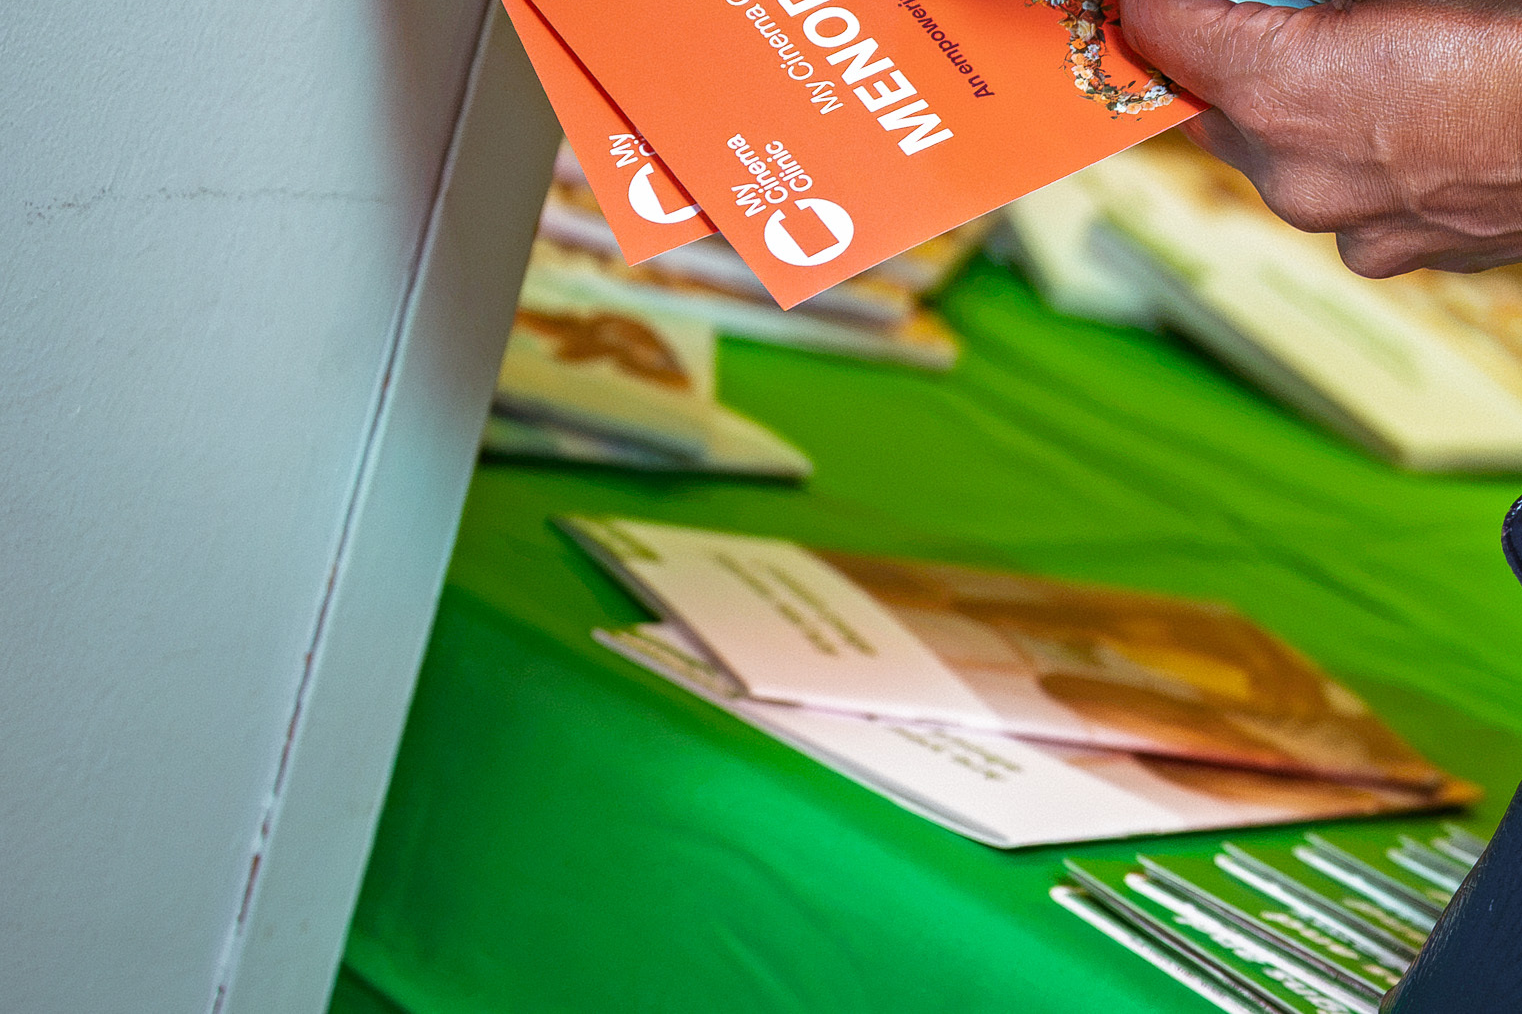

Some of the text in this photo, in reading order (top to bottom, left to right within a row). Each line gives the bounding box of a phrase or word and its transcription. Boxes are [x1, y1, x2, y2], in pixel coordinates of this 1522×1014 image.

[745, 3, 814, 81] Cinema
[804, 80, 844, 115] My
[967, 74, 995, 98] An
[608, 134, 639, 168] My
[764, 140, 814, 193] Clinic
[726, 133, 789, 205] Cinema
[730, 183, 773, 218] My
